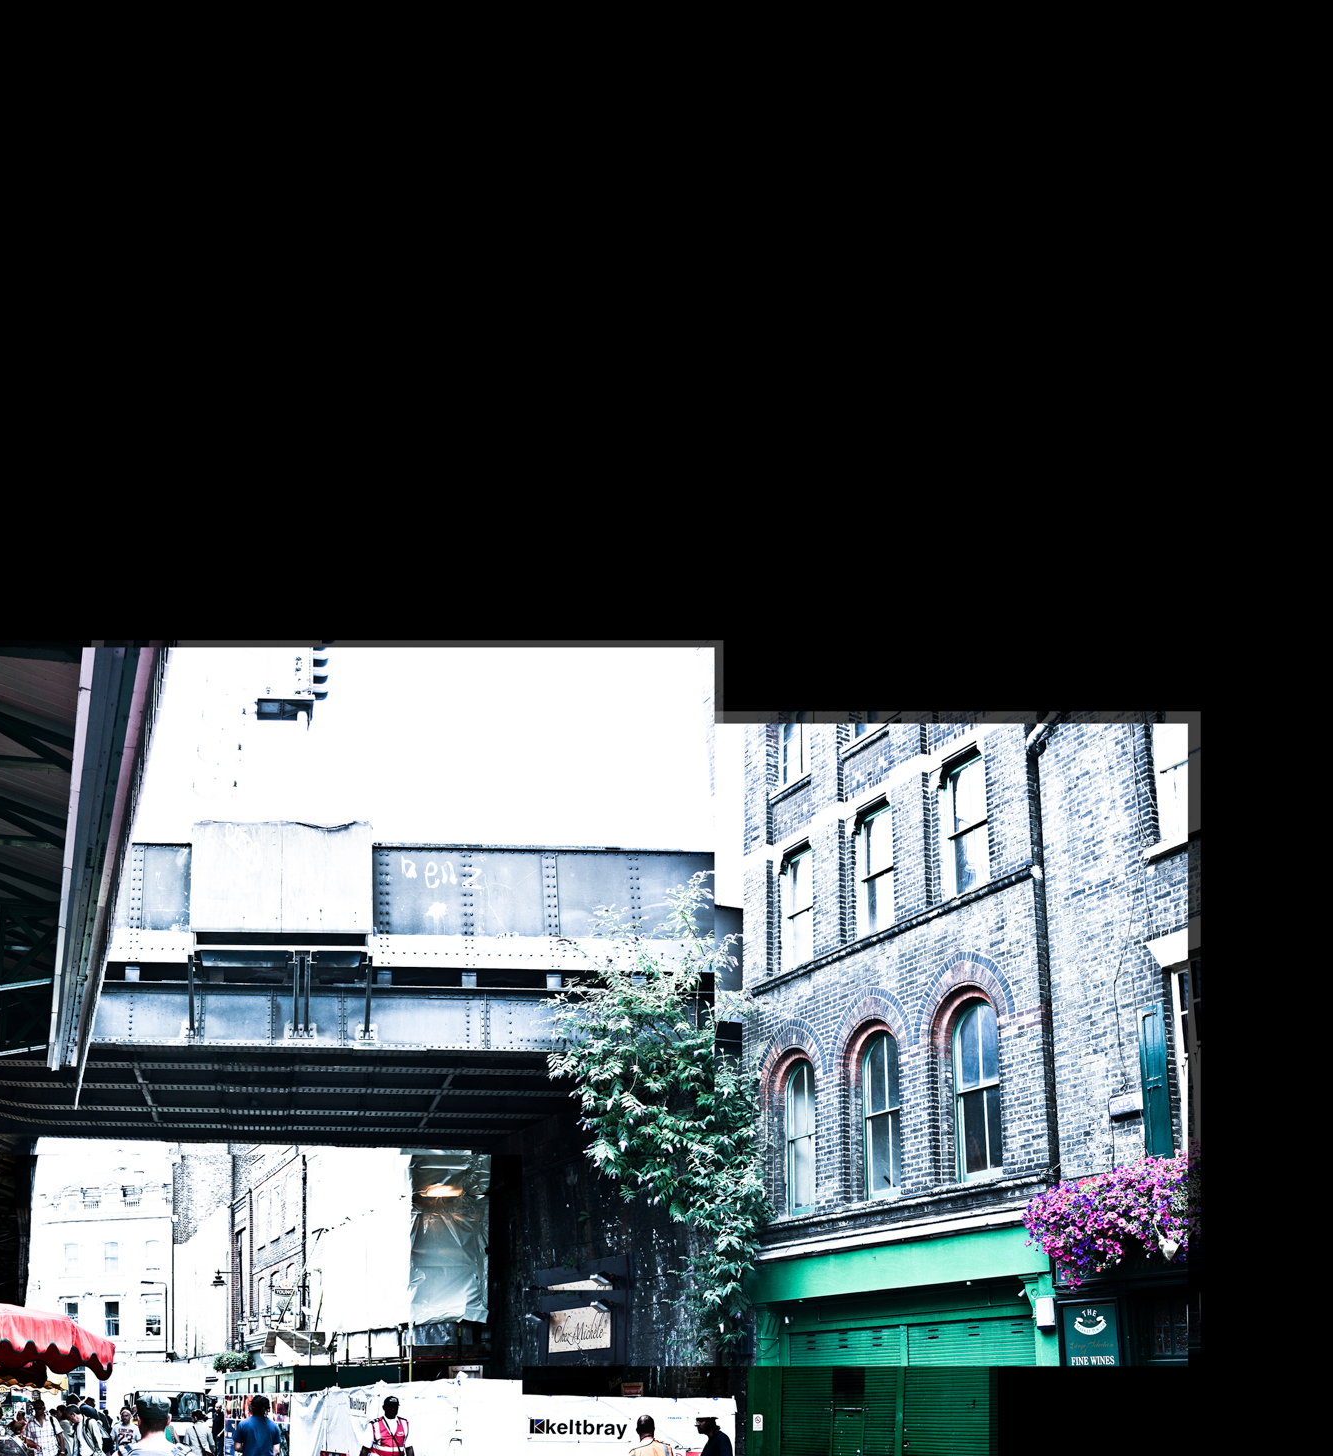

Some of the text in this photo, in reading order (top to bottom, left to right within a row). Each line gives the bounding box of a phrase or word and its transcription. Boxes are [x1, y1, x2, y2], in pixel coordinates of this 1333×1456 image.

[1081, 1309, 1097, 1317] THE
[1071, 1355, 1115, 1366] FINE WINES
[546, 1419, 627, 1440] keltbray
